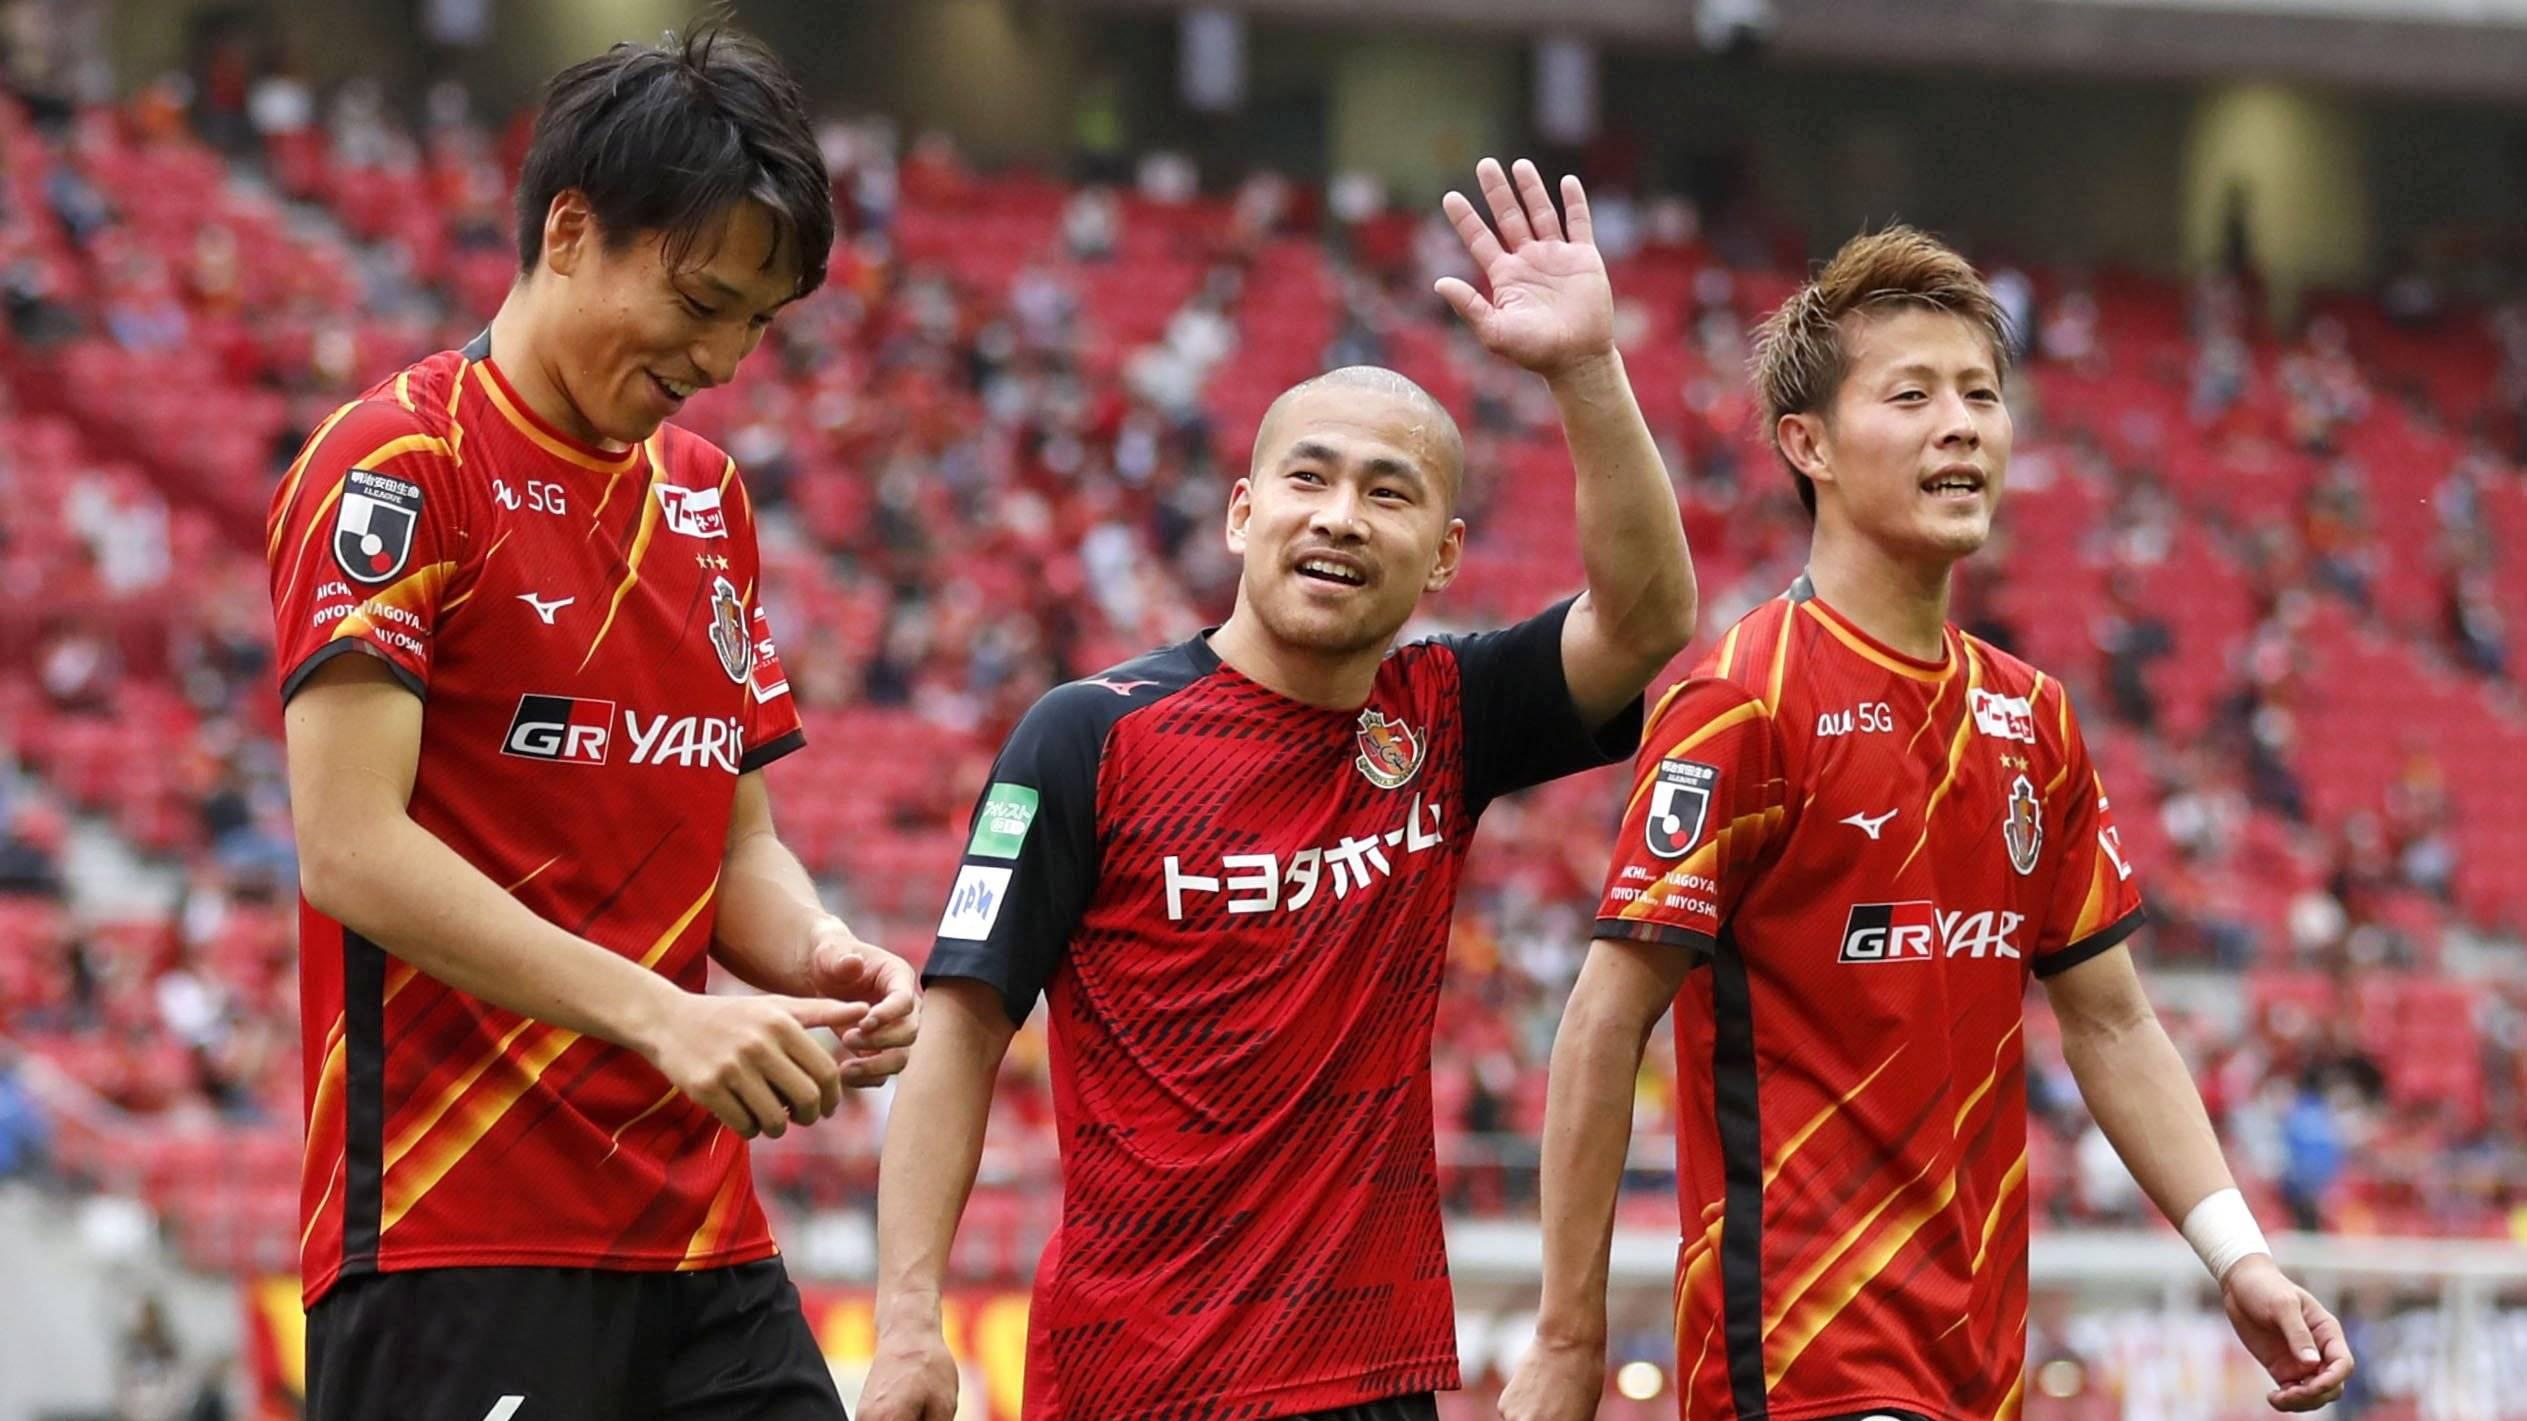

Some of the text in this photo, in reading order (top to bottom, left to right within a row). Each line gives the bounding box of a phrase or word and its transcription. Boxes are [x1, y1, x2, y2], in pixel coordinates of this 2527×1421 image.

[527, 480, 566, 515] 5G
[1859, 701, 1893, 733] 5G
[510, 721, 607, 761] GR
[1163, 791, 1444, 921] トヨタホーム
[1664, 872, 1717, 894] NAGOYA
[1846, 924, 1931, 958] GR
